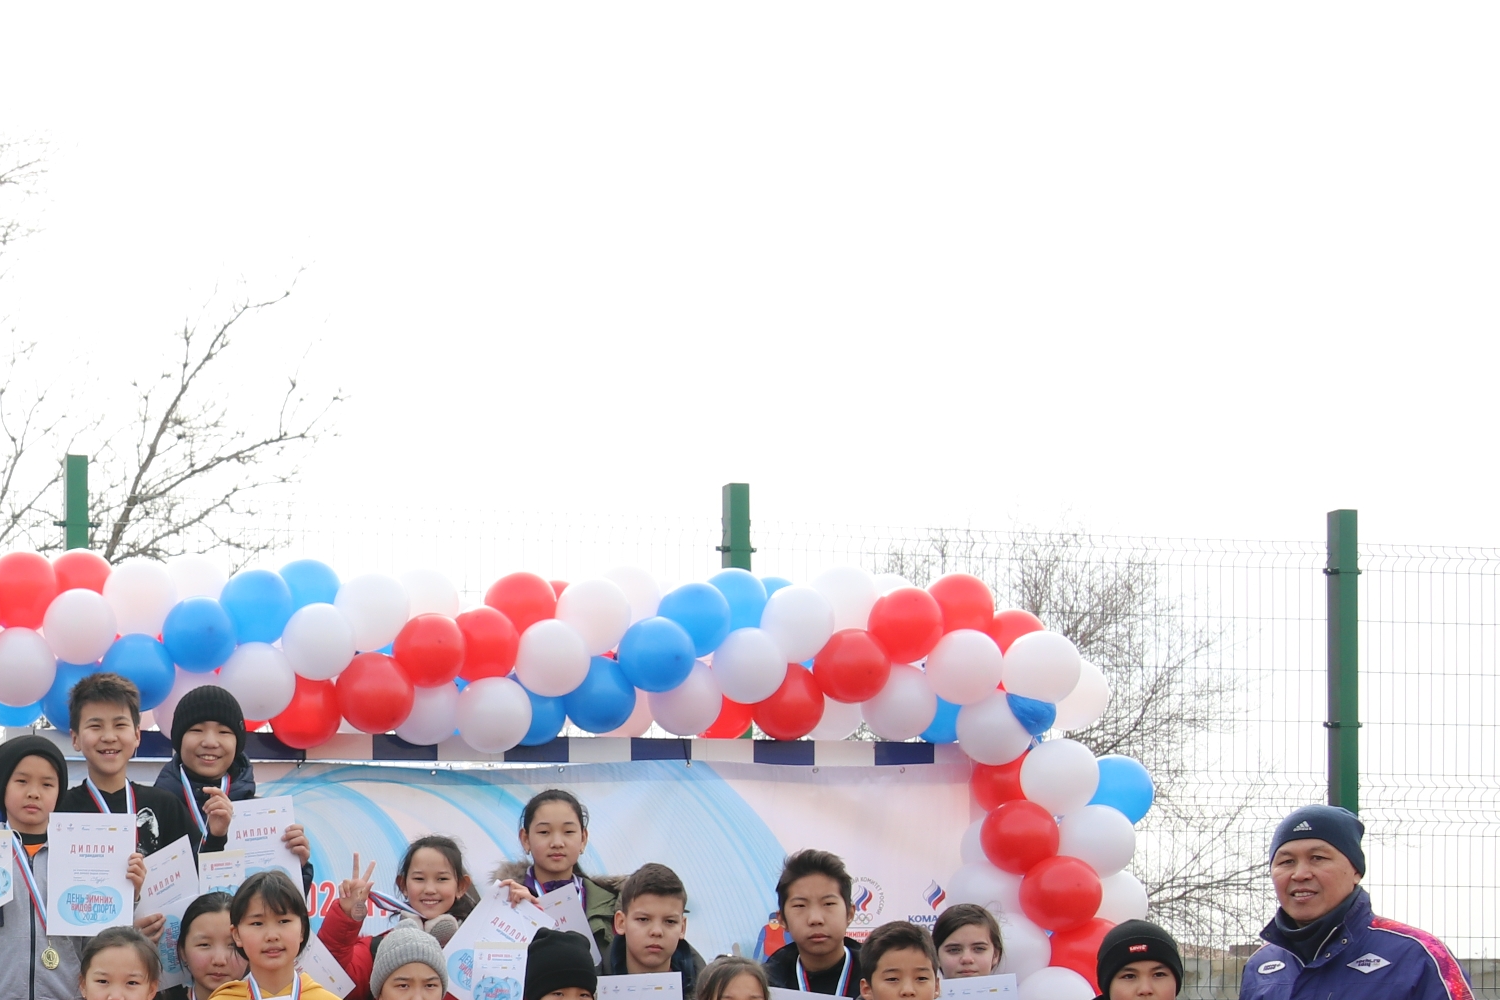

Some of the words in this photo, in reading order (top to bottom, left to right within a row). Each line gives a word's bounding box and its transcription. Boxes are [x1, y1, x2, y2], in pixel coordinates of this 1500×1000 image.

[235, 826, 277, 840] ДИПЛОМ
[70, 844, 115, 854] ДИПЛОМ
[147, 870, 182, 896] ДИПЛОМ
[860, 876, 883, 892] КОМИТЕТ
[876, 892, 885, 915] РОССИИ
[71, 903, 92, 913] ВИДОВ
[92, 904, 117, 914] СПОРТА
[82, 913, 98, 921] 2020
[908, 915, 938, 923] КОМА
[490, 916, 527, 943] ДИПЛОМ
